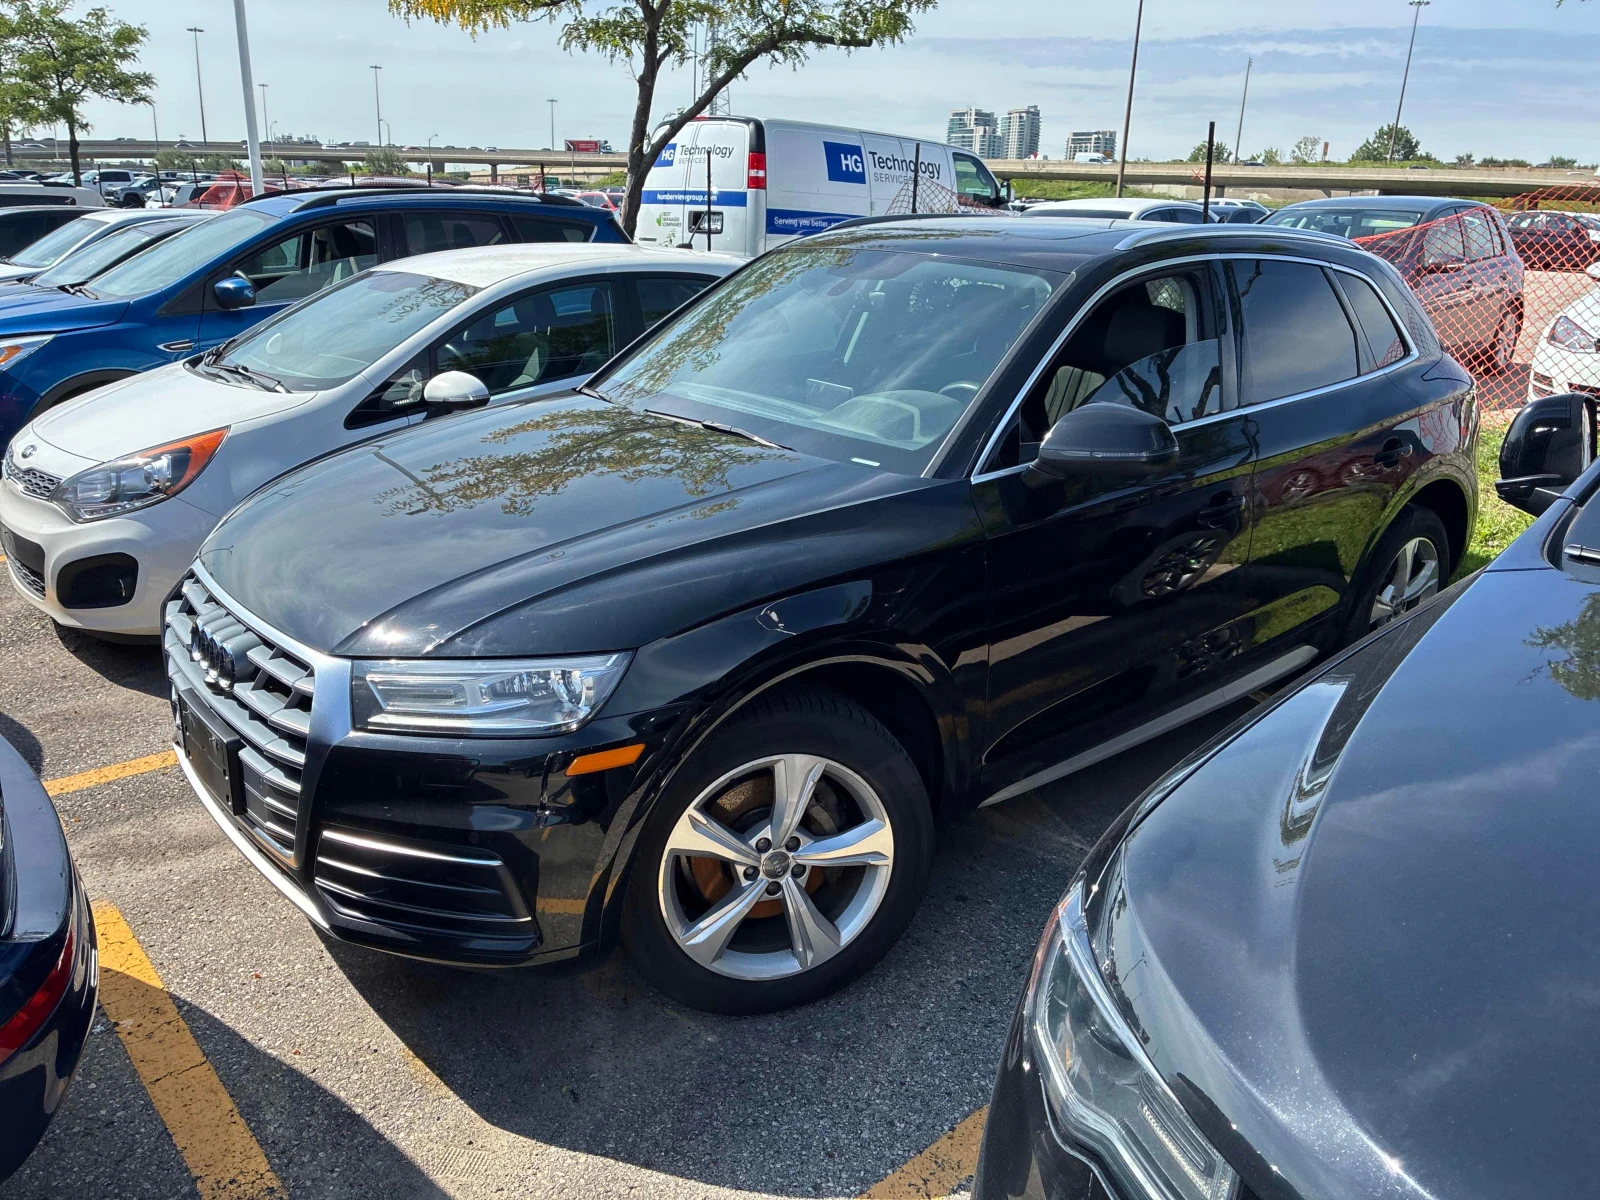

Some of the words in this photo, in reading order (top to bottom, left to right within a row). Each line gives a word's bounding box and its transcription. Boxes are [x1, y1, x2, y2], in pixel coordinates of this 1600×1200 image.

[661, 149, 675, 161] HG
[680, 144, 734, 159] Technology
[840, 153, 863, 172] HG
[868, 151, 941, 180] Technoogy
[656, 192, 718, 203] humberviewgroup.cm
[773, 216, 798, 228] Serving
[799, 219, 810, 228] you
